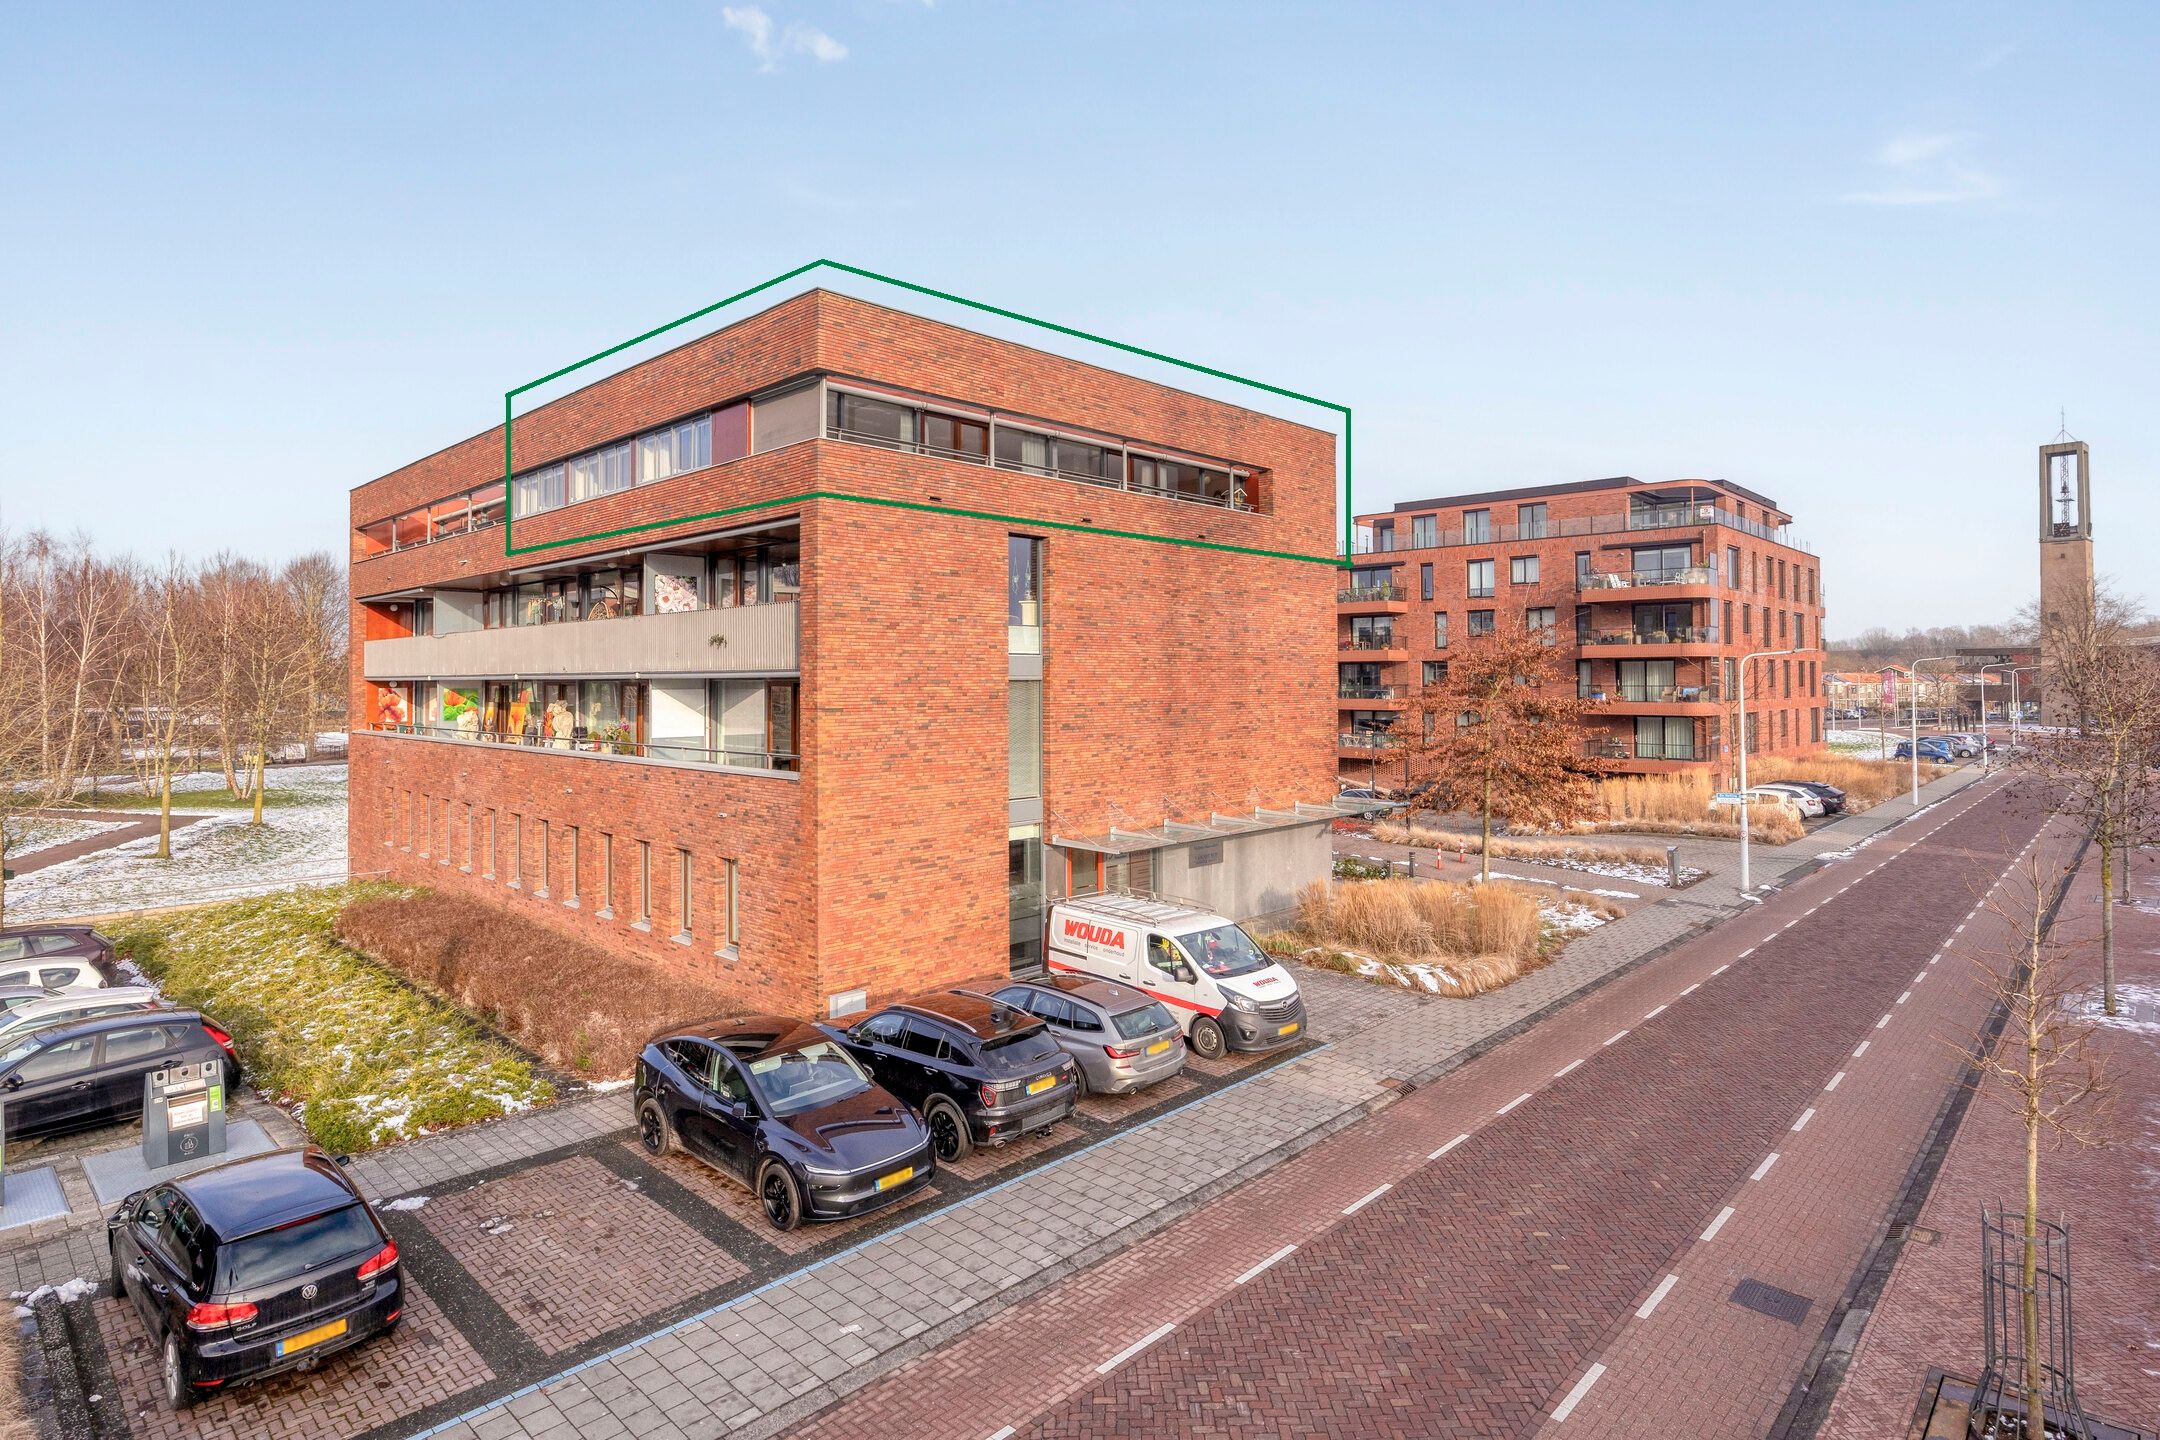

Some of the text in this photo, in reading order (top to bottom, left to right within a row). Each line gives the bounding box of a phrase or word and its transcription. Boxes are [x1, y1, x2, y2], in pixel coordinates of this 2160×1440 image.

[1064, 919, 1125, 949] WOUDA
[1252, 977, 1279, 987] WOUDA
[236, 1322, 257, 1332] GOLF
